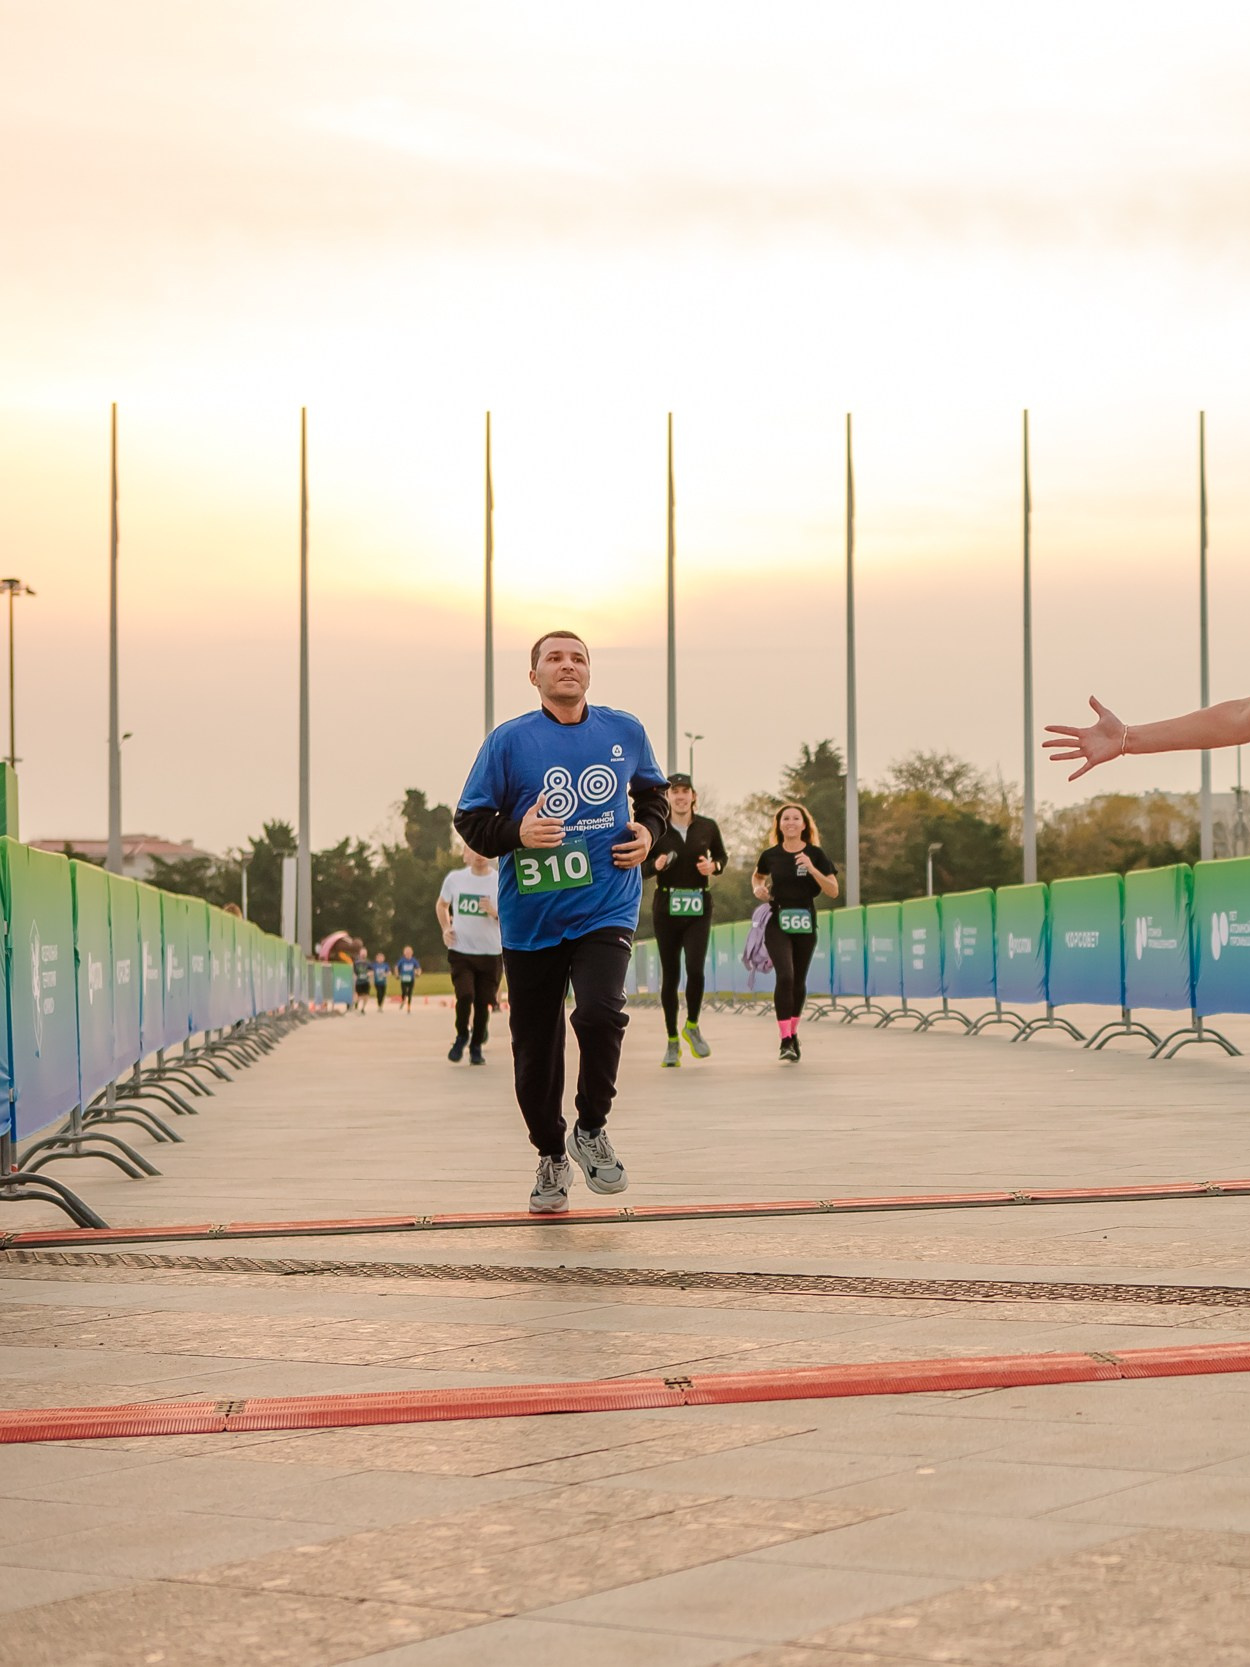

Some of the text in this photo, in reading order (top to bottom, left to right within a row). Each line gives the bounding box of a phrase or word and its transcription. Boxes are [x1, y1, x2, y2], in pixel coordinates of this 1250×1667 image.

[561, 822, 615, 832] ЫШЛЕННОСТИ
[576, 815, 615, 826] АТОМНОЙ
[520, 851, 588, 886] 310
[672, 897, 702, 912] 570
[781, 915, 811, 930] 566
